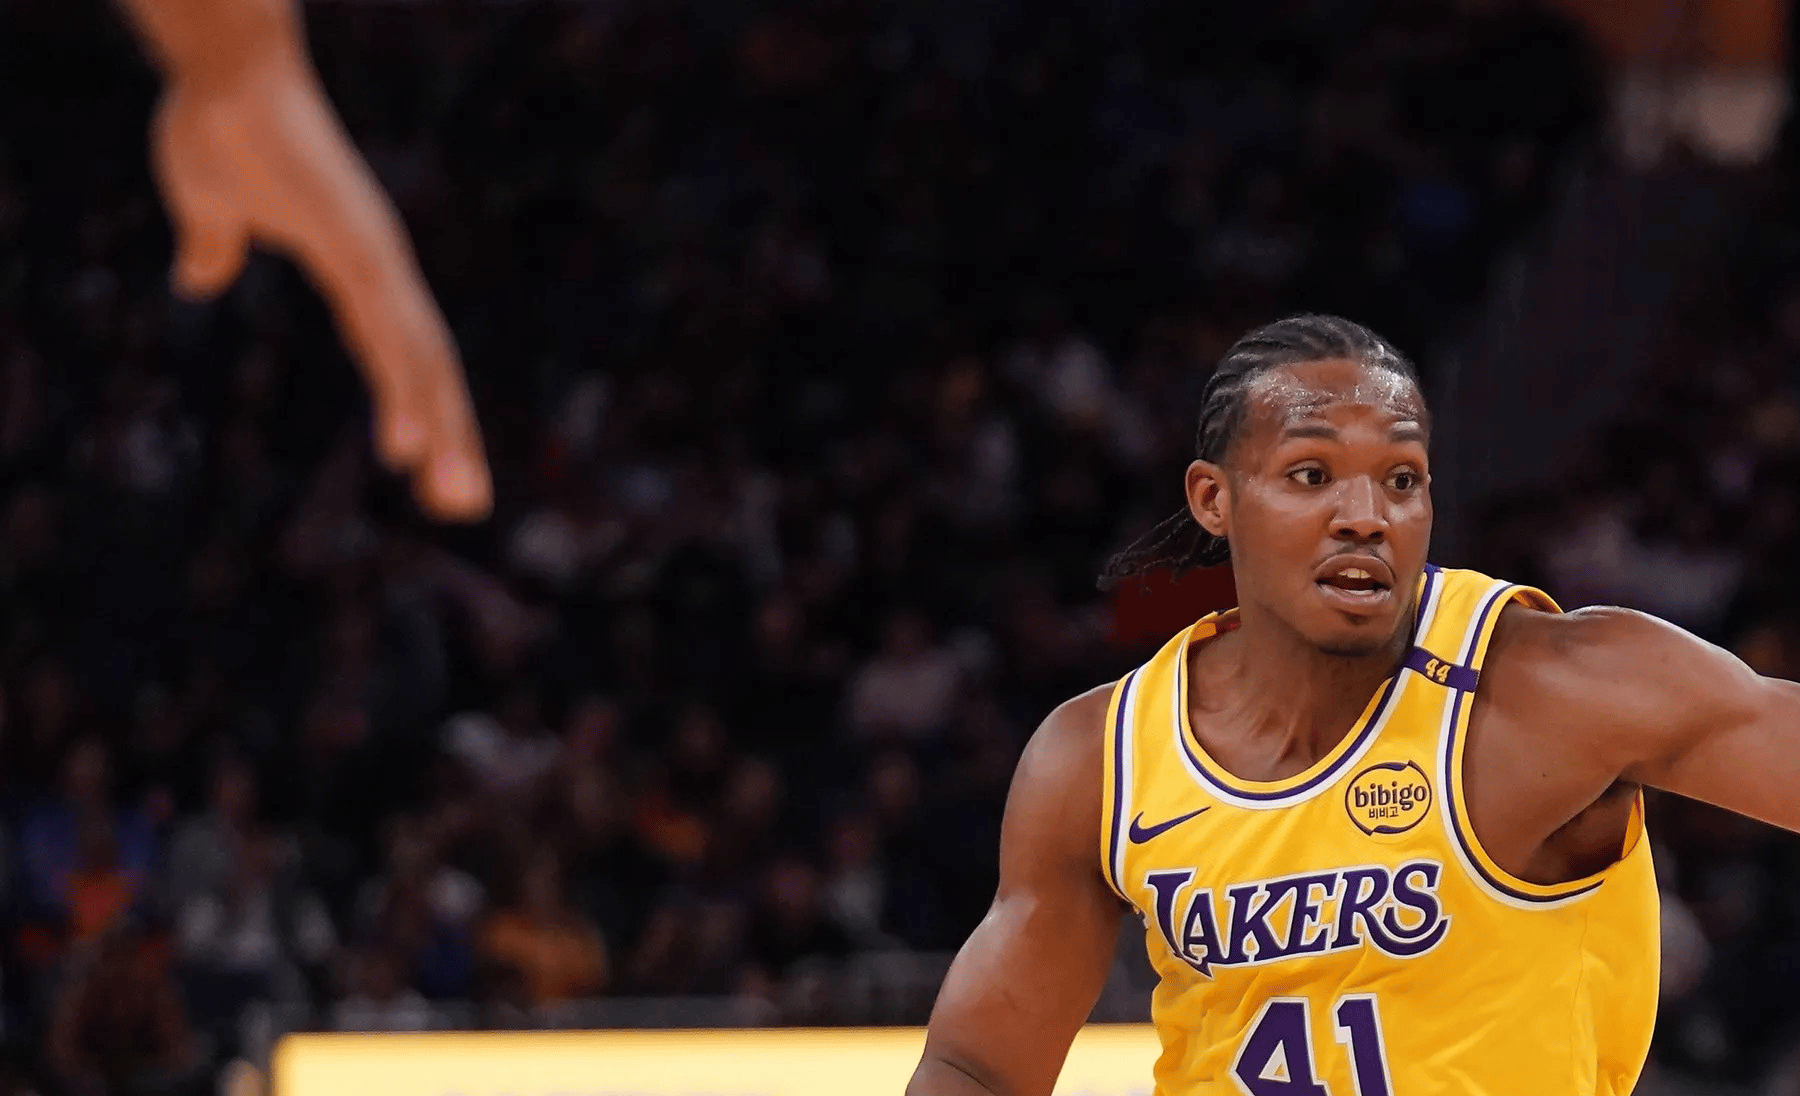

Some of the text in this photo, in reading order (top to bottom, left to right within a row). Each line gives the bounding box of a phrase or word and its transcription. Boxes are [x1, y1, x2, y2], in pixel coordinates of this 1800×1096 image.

[1425, 658, 1452, 683] 44
[1354, 780, 1428, 811] bibigo
[1368, 806, 1400, 820] 비비고
[1145, 860, 1454, 979] LAKERS
